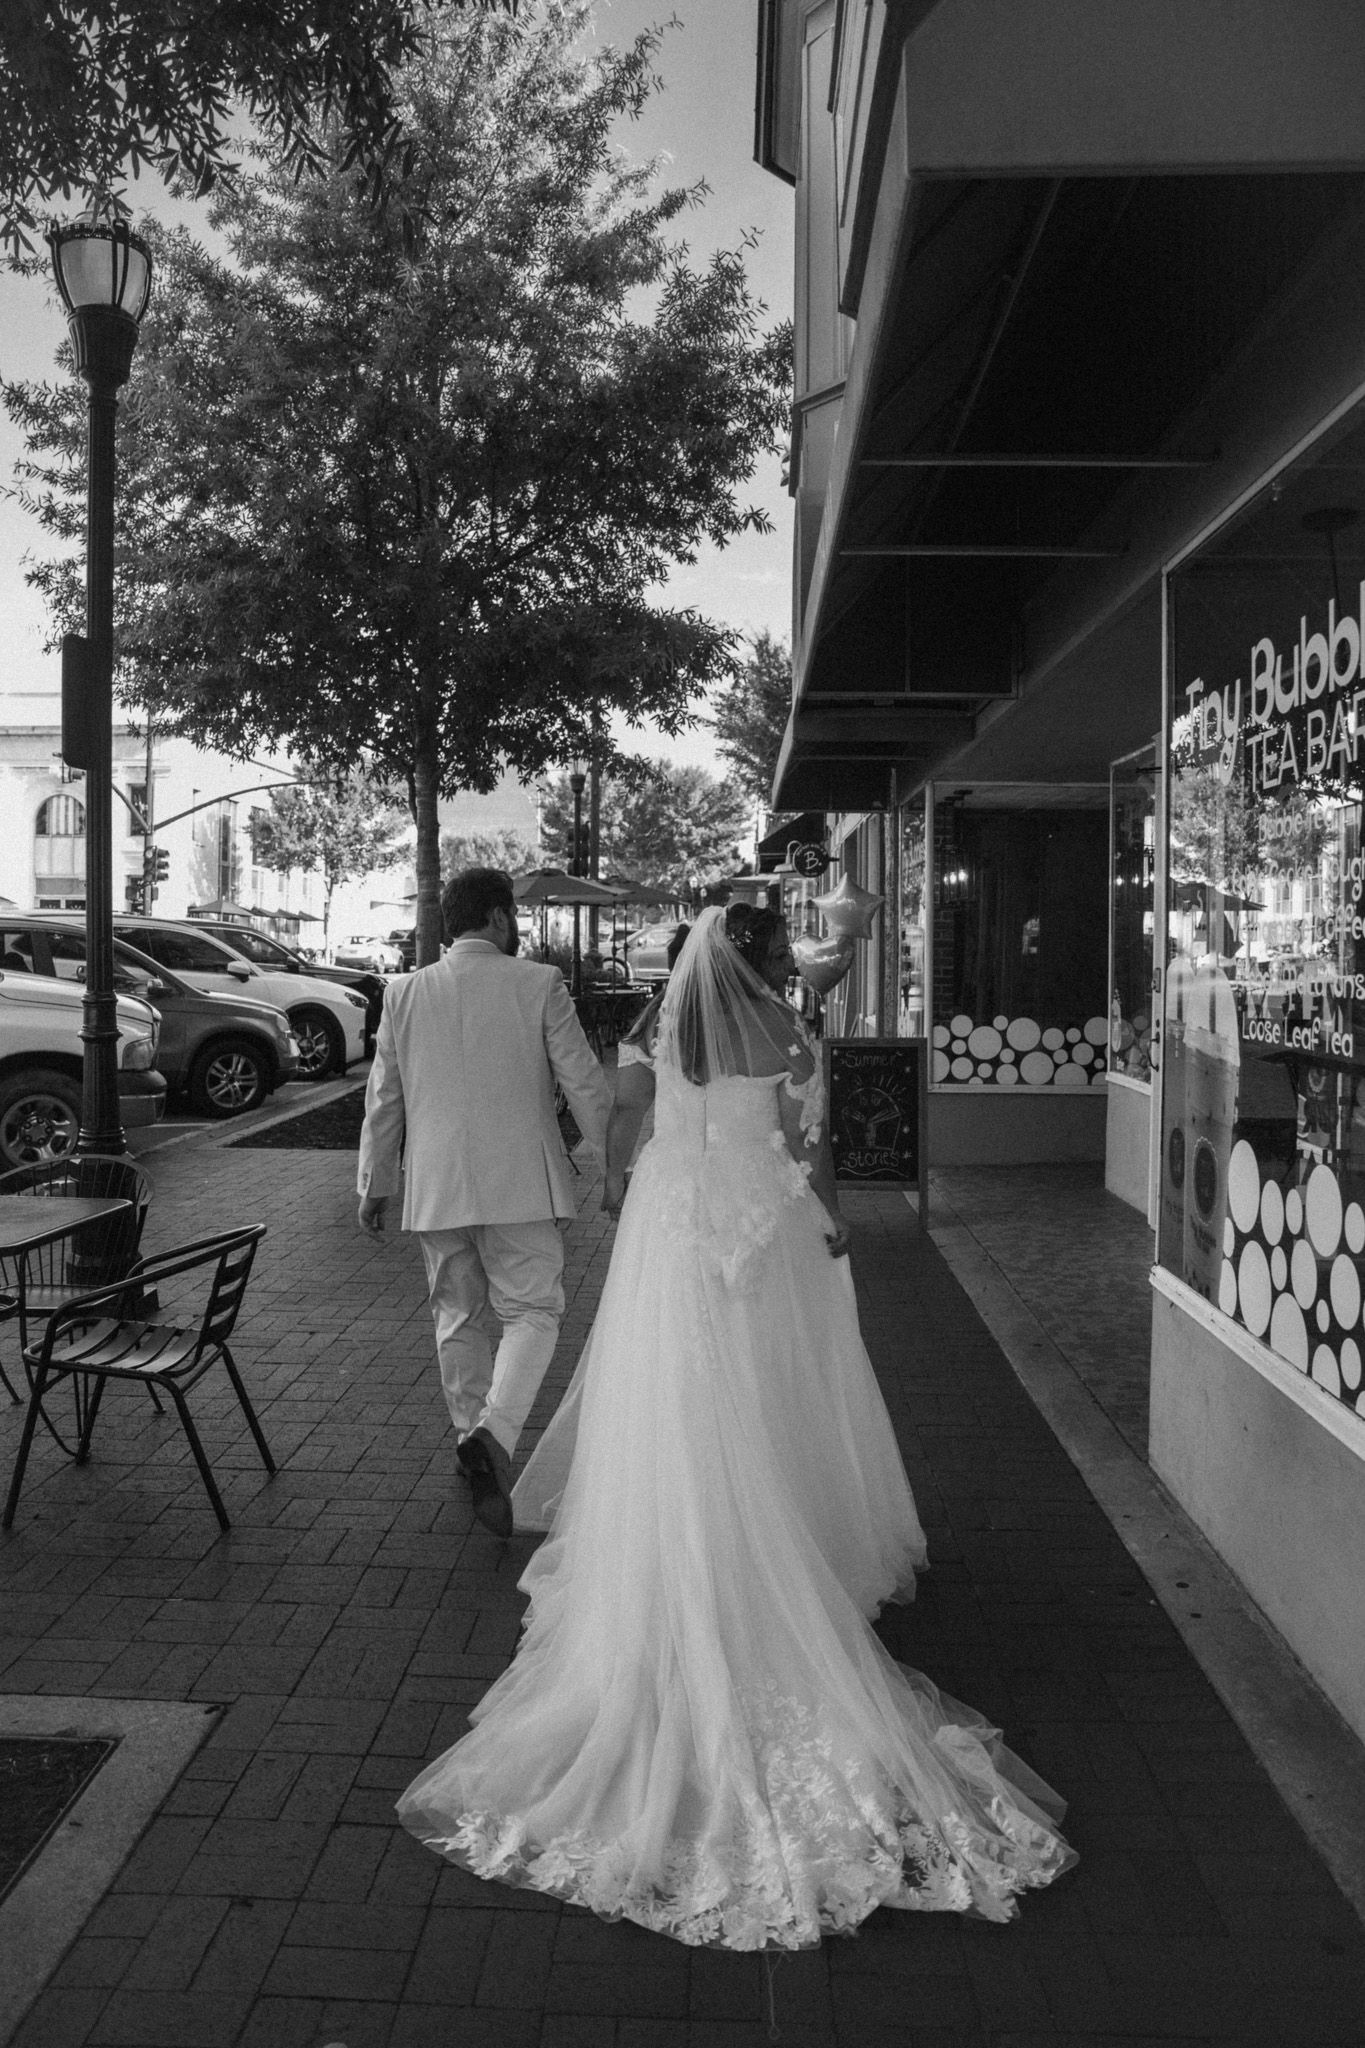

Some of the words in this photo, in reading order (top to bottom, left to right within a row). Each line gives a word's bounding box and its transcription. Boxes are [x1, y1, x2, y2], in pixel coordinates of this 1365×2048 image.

[1185, 677, 1241, 786] Tiny
[1247, 722, 1299, 792] TEA
[1258, 806, 1303, 842] Bubble
[1305, 800, 1337, 832] Tea
[1315, 904, 1365, 940] Coffe
[1242, 1012, 1282, 1045] Loose
[1284, 1016, 1321, 1051] Leaf
[1324, 1020, 1354, 1058] Tea
[844, 1050, 896, 1068] Summer
